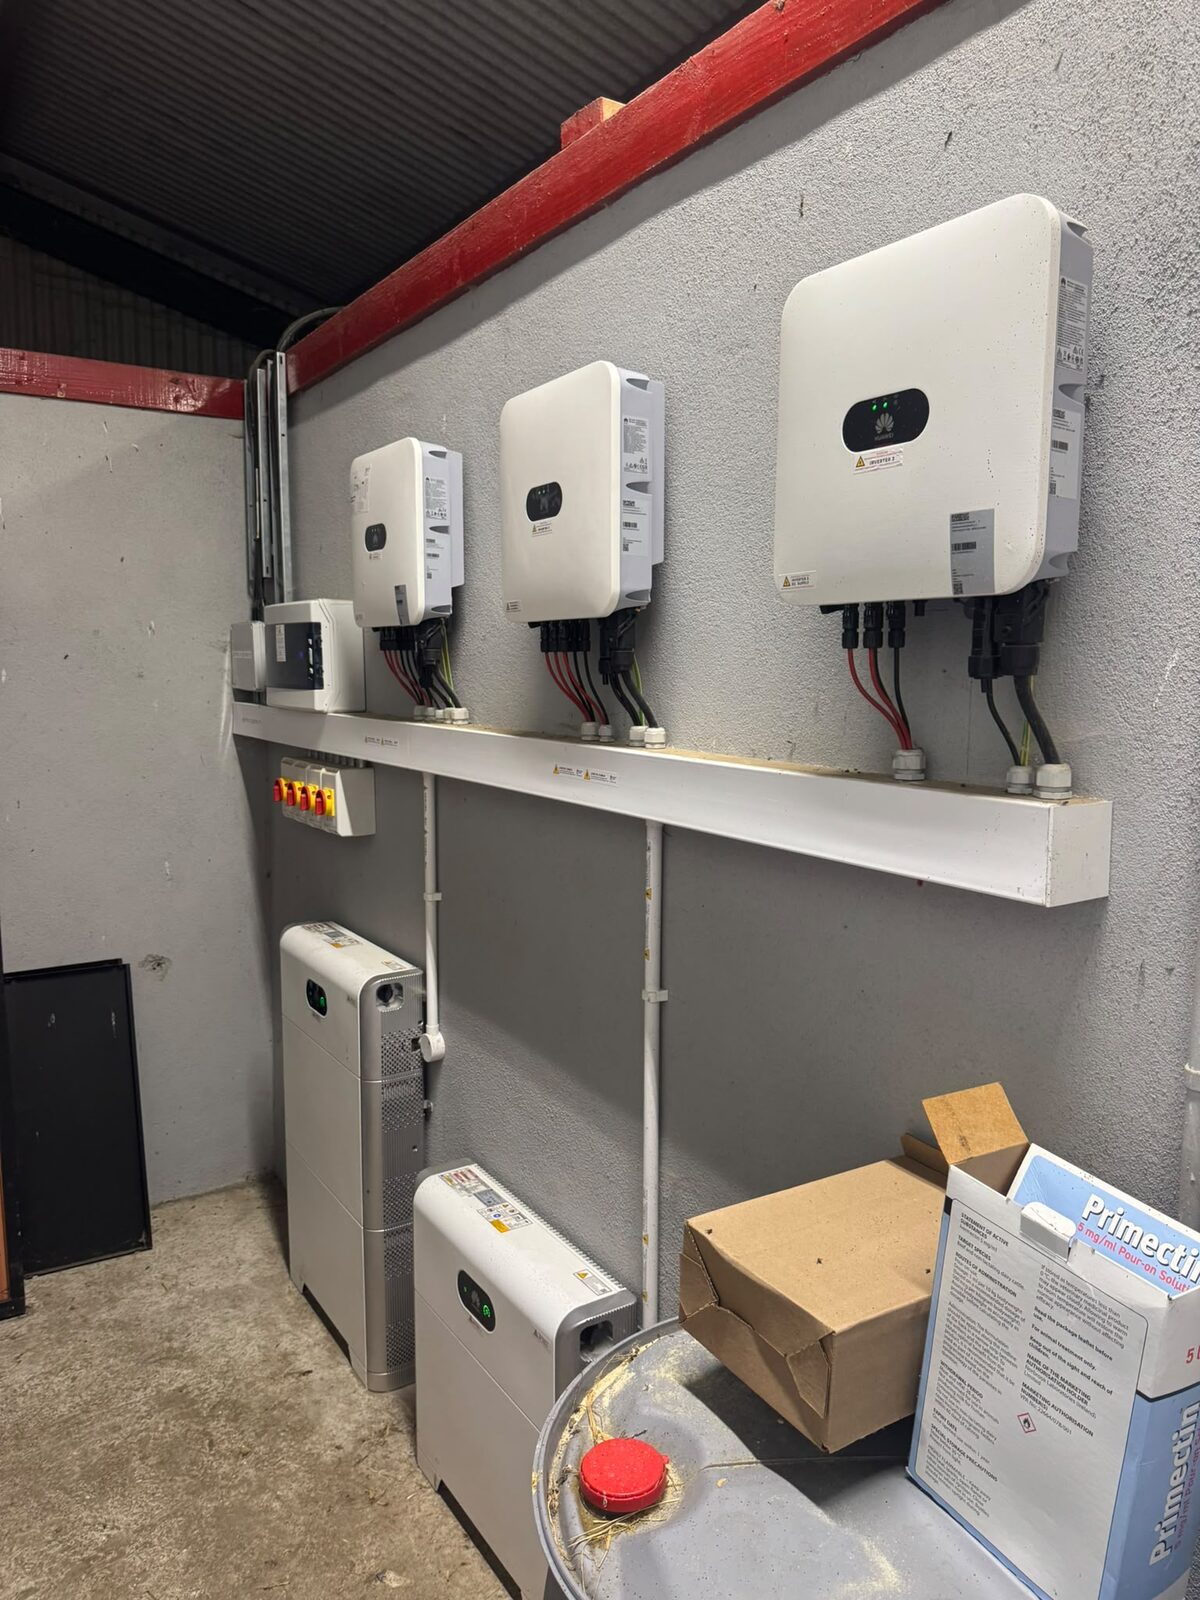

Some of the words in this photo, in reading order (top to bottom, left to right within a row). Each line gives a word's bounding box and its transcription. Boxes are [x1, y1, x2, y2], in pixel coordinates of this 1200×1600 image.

[958, 1235, 973, 1249] TARGET
[974, 1246, 991, 1261] SPECIES
[960, 1218, 987, 1239] SUBSTANCES
[961, 1213, 985, 1232] STATEMENT
[992, 1233, 1008, 1247] ACTIVE
[1077, 1222, 1085, 1232] 5
[1085, 1228, 1118, 1252] mg/ml
[1118, 1246, 1157, 1276] Pour-on
[955, 1252, 971, 1266] ROUTES
[978, 1268, 1016, 1298] ADMINISTRATION
[1045, 1267, 1060, 1280] stored
[1065, 1280, 1097, 1305] temperatures
[1098, 1301, 1107, 1311] less
[1108, 1307, 1120, 1319] than
[1033, 1313, 1043, 1322] use.
[1037, 1289, 1053, 1302] normal
[1054, 1301, 1081, 1322] appearance
[1082, 1318, 1101, 1334] without
[1101, 1331, 1124, 1350] affecting
[1039, 1278, 1048, 1287] may
[1049, 1284, 1066, 1298] appear
[1084, 1306, 1105, 1324] Allowing
[1112, 1325, 1128, 1337] warm
[1044, 1287, 1056, 1298] room
[1056, 1295, 1086, 1318] temperature
[1086, 1314, 1095, 1323] will
[1096, 1320, 1113, 1335] restore
[1114, 1332, 1123, 1341] the
[1059, 1283, 1083, 1303] veterinary
[1083, 1298, 1107, 1317] medicinal
[1108, 1314, 1129, 1332] product
[1029, 1342, 1050, 1359] children.
[1034, 1306, 1046, 1317] Read
[1047, 1315, 1055, 1323] the
[1056, 1321, 1077, 1339] package
[1078, 1335, 1094, 1349] leaflet
[1095, 1346, 1112, 1361] before
[1040, 1330, 1057, 1344] animal
[1058, 1342, 1083, 1362] treatment
[1083, 1359, 1096, 1372] only.
[1186, 1347, 1194, 1364] 5
[1026, 1359, 1066, 1390] AUTHORISATION
[1066, 1387, 1088, 1406] HOLDER
[1027, 1353, 1041, 1366] NAME
[1042, 1363, 1049, 1371] OF
[1050, 1369, 1059, 1378] THE
[1060, 1376, 1091, 1401] MARKETING
[1030, 1336, 1042, 1348] Keep
[1042, 1344, 1051, 1353] out
[1058, 1355, 1066, 1364] the
[1066, 1361, 1079, 1374] sight
[1080, 1370, 1090, 1380] and
[1091, 1378, 1105, 1391] reach
[1021, 1388, 1048, 1410] NUMBER(S)
[1022, 1382, 1050, 1406] MARKETING
[1051, 1403, 1093, 1436] AUTHORISATION
[1046, 1380, 1075, 1404] Laboratories
